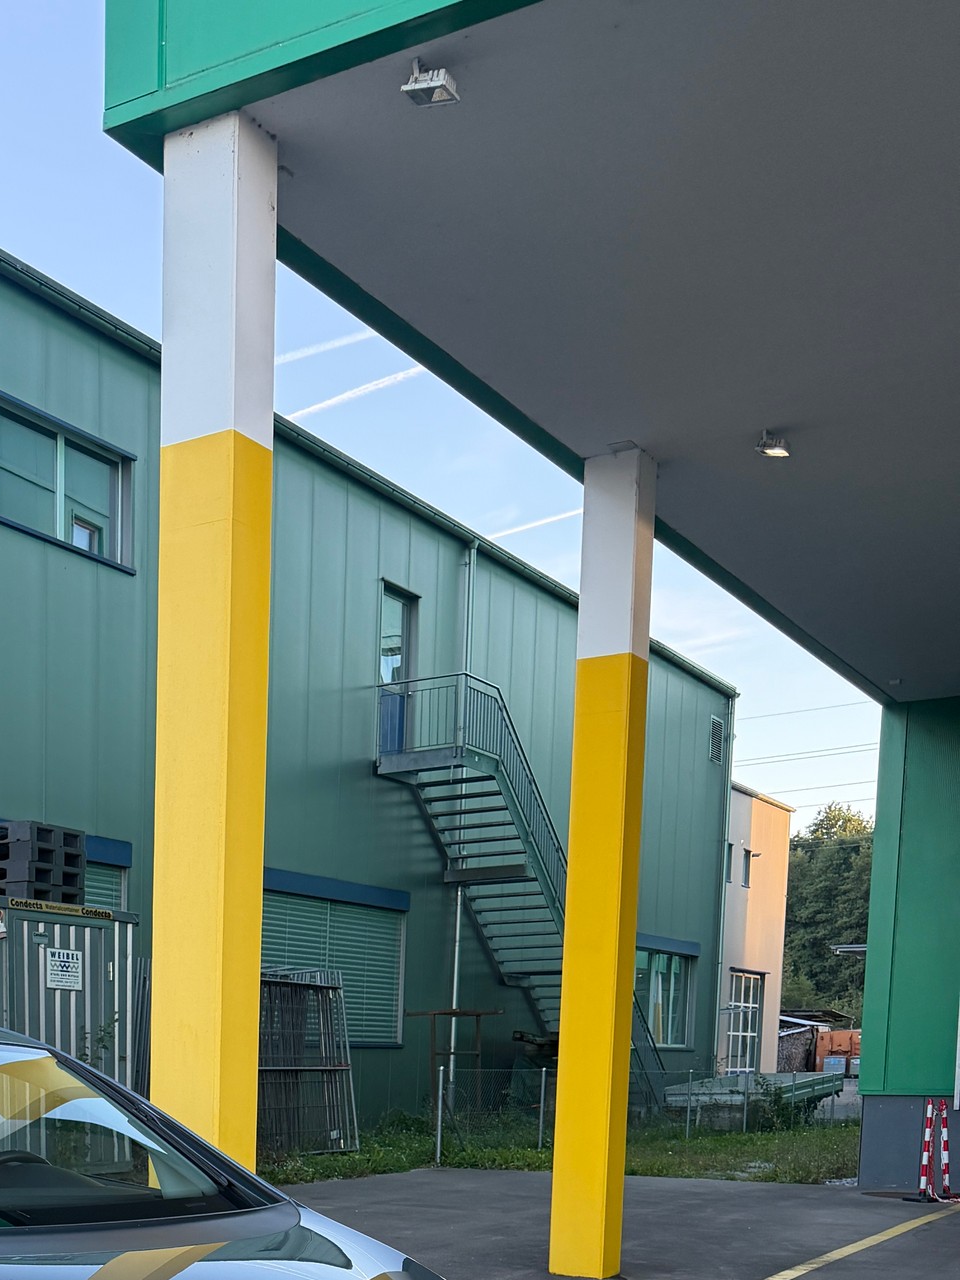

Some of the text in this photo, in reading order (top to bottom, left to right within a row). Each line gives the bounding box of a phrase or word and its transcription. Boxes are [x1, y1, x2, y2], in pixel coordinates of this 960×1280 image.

[10, 899, 43, 909] Condecta
[81, 908, 112, 919] Condecta
[50, 951, 79, 960] WEIBEL
